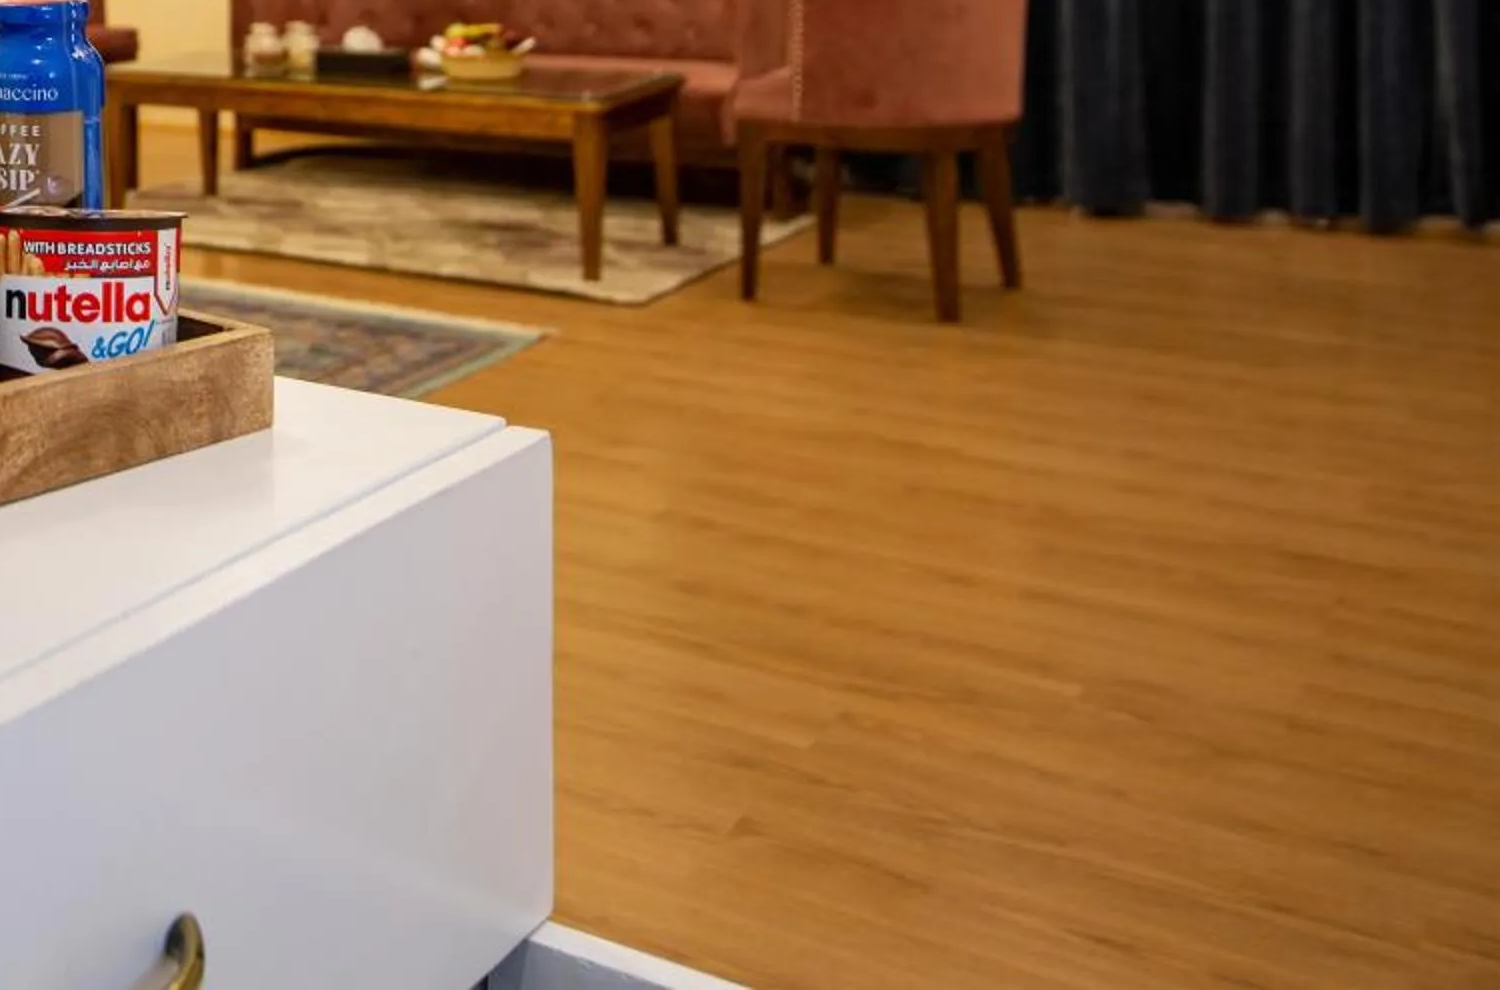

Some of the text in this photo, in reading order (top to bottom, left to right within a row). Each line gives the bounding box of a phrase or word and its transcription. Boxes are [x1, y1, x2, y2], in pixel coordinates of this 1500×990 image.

[24, 240, 152, 256] WITH BREADSTICKS
[6, 281, 152, 323] nutella
